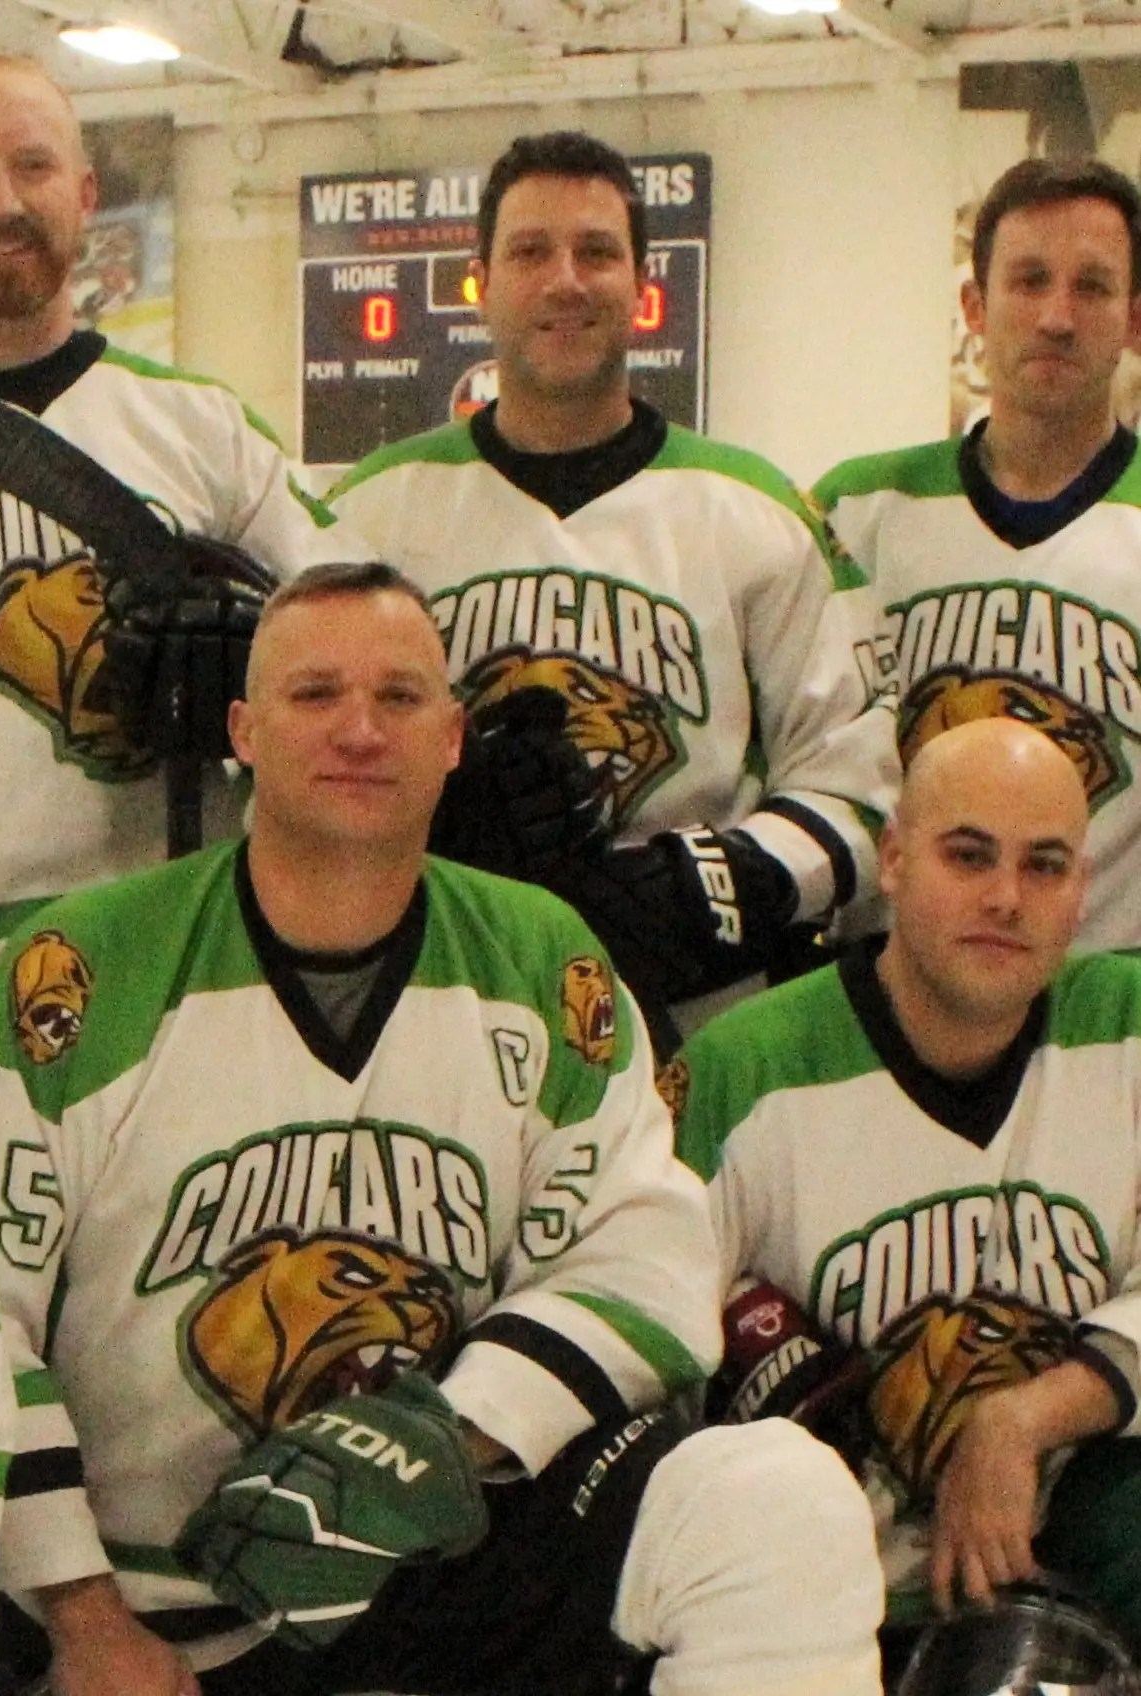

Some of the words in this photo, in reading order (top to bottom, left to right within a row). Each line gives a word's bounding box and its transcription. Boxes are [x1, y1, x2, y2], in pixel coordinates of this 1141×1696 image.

[310, 180, 417, 225] WE'RE
[332, 263, 399, 293] HOME
[364, 293, 396, 343] 0
[355, 358, 420, 379] PENALTY
[134, 1116, 491, 1297] COUGARS
[519, 1142, 599, 1264] 5
